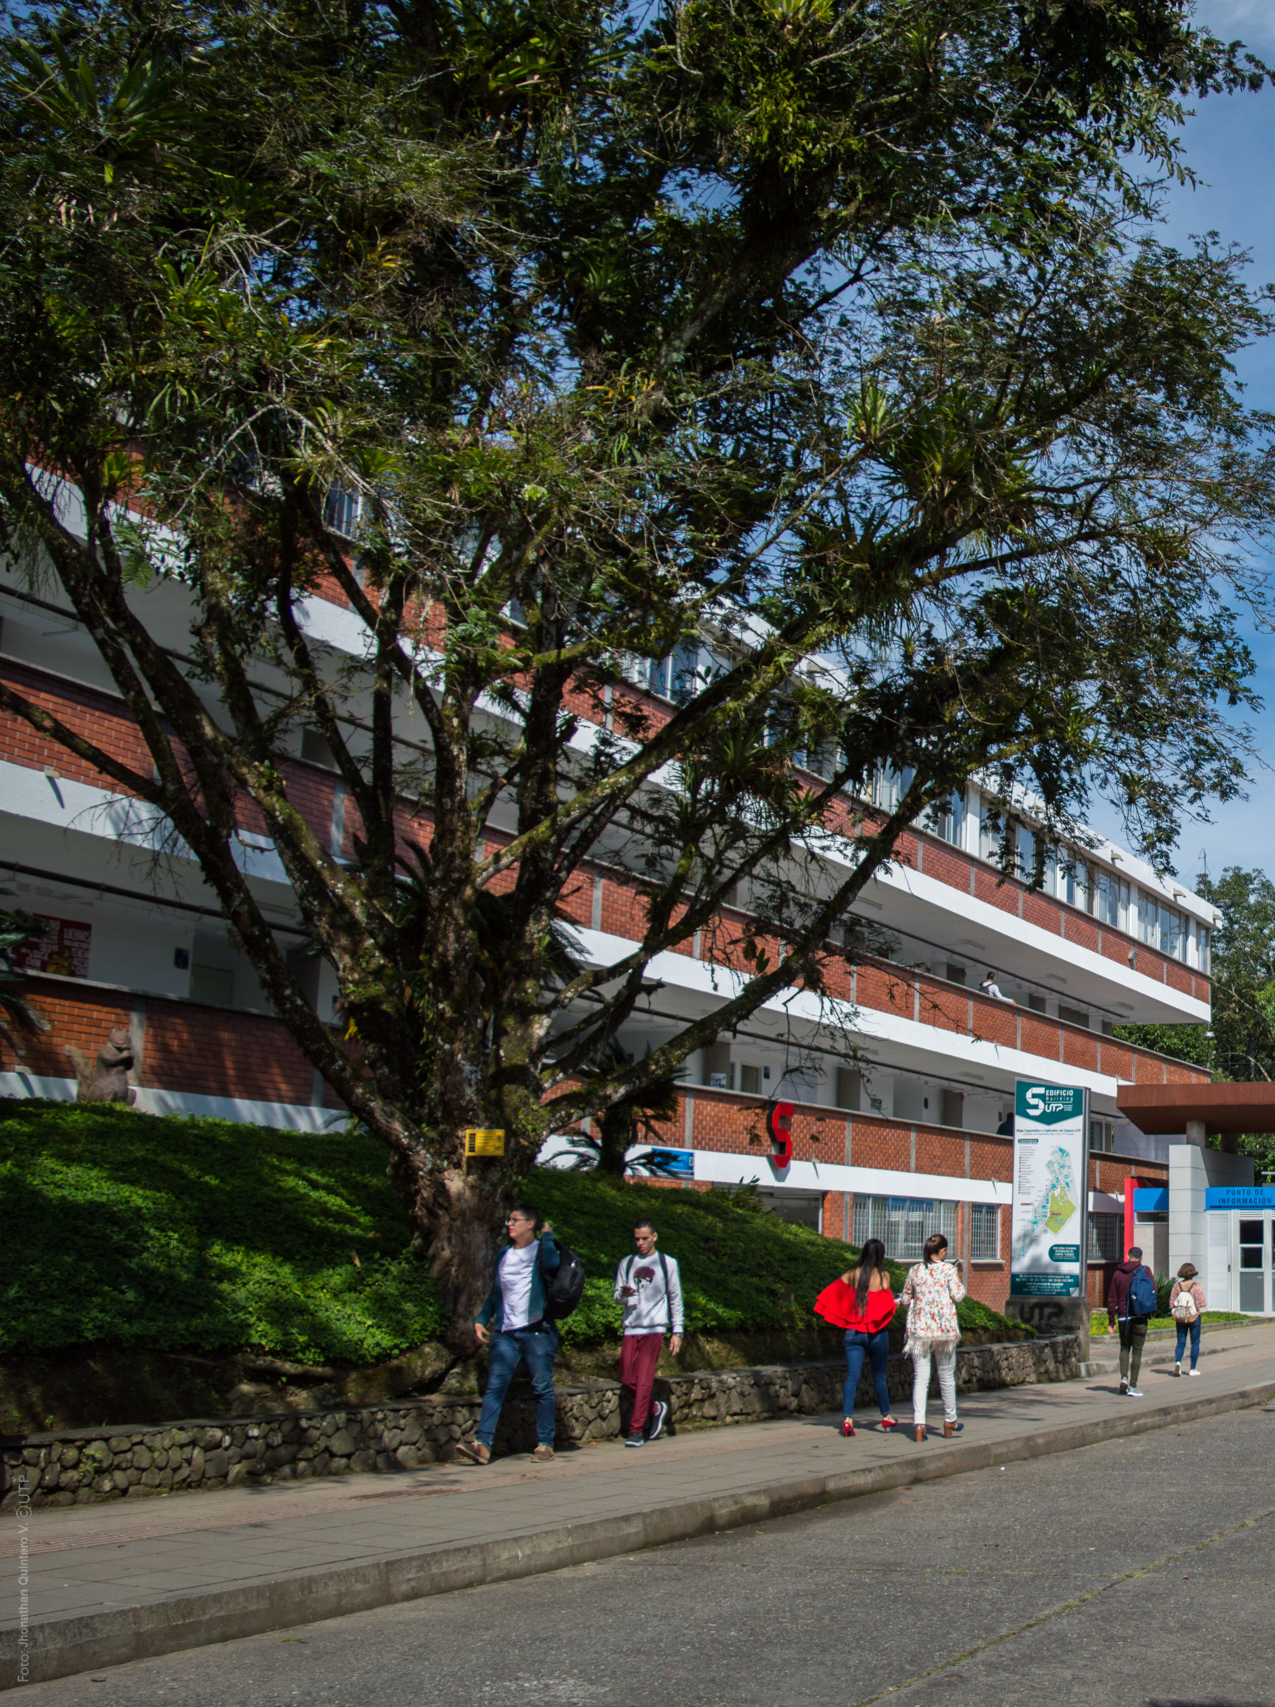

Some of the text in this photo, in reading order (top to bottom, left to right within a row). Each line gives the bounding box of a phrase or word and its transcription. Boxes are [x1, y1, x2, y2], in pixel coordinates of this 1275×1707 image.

[1045, 1103, 1064, 1112] UTP
[1226, 1188, 1264, 1196] PUNTO DE
[1218, 1196, 1272, 1205] INFORMACIÓN
